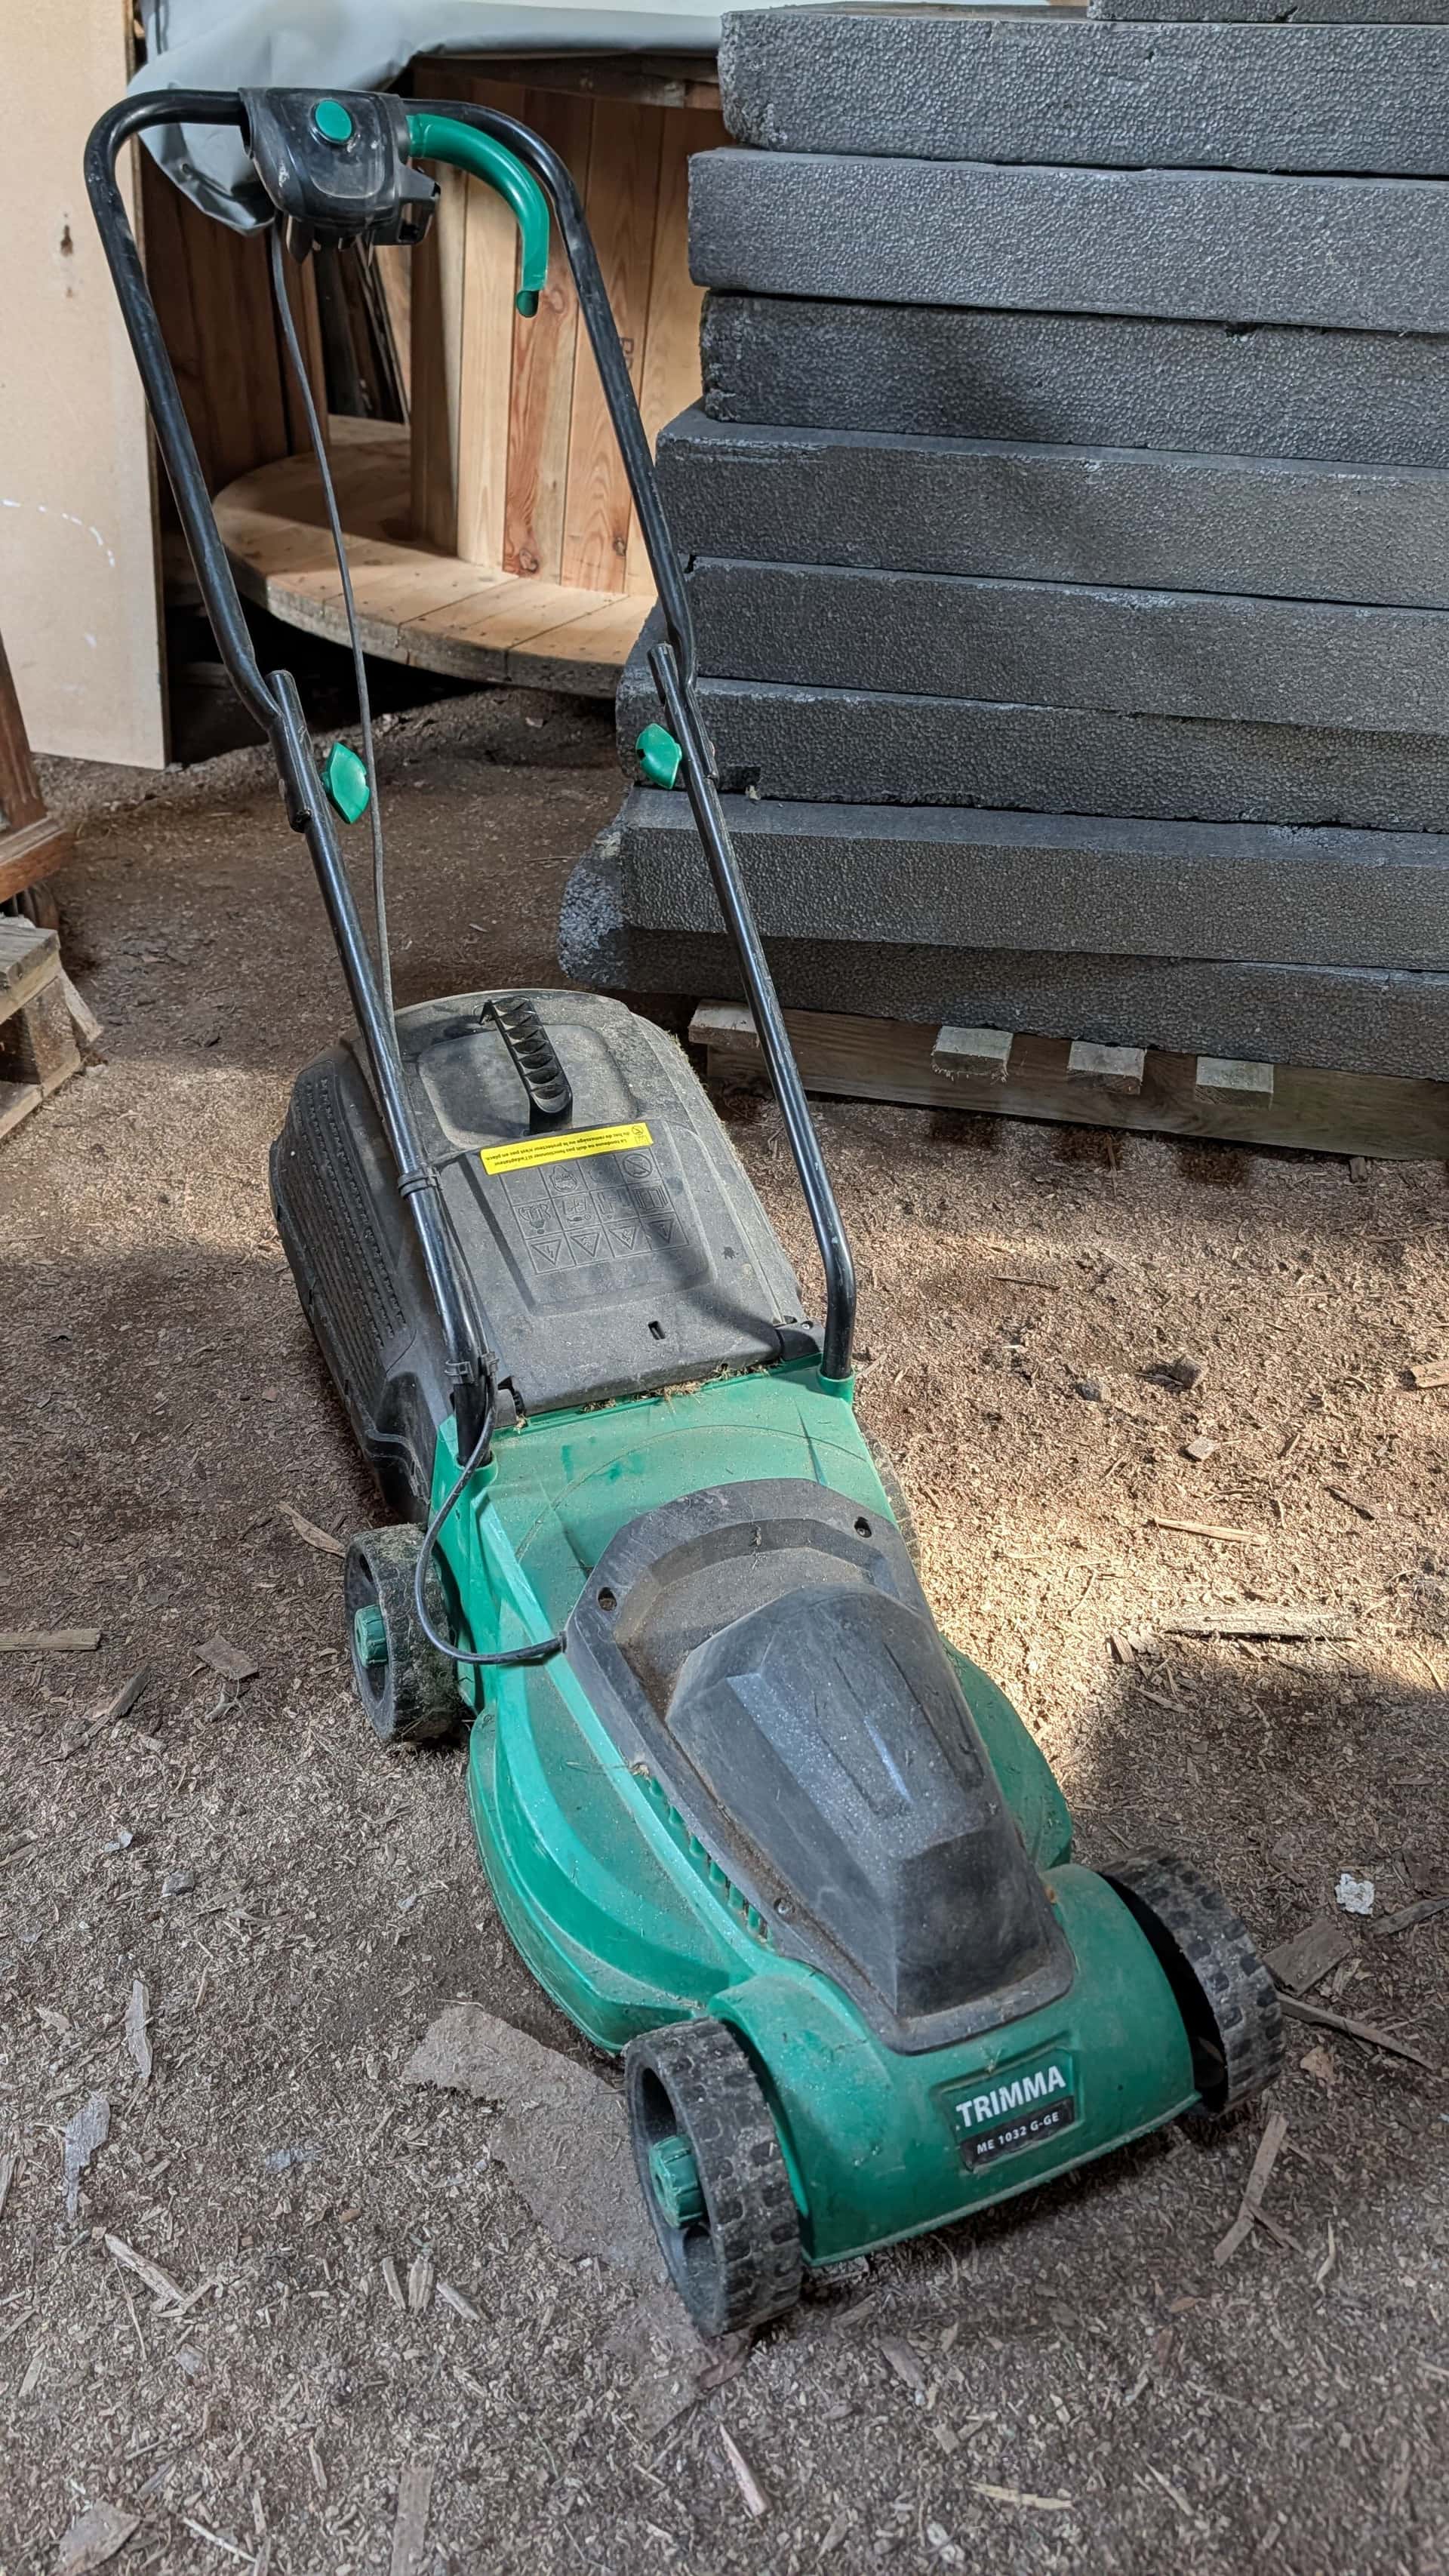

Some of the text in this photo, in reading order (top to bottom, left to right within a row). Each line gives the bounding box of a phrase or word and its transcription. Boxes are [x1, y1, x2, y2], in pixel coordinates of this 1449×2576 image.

[955, 2065, 1066, 2128] TRIMMA
[977, 2112, 1060, 2154] ME 1032 G-GE
